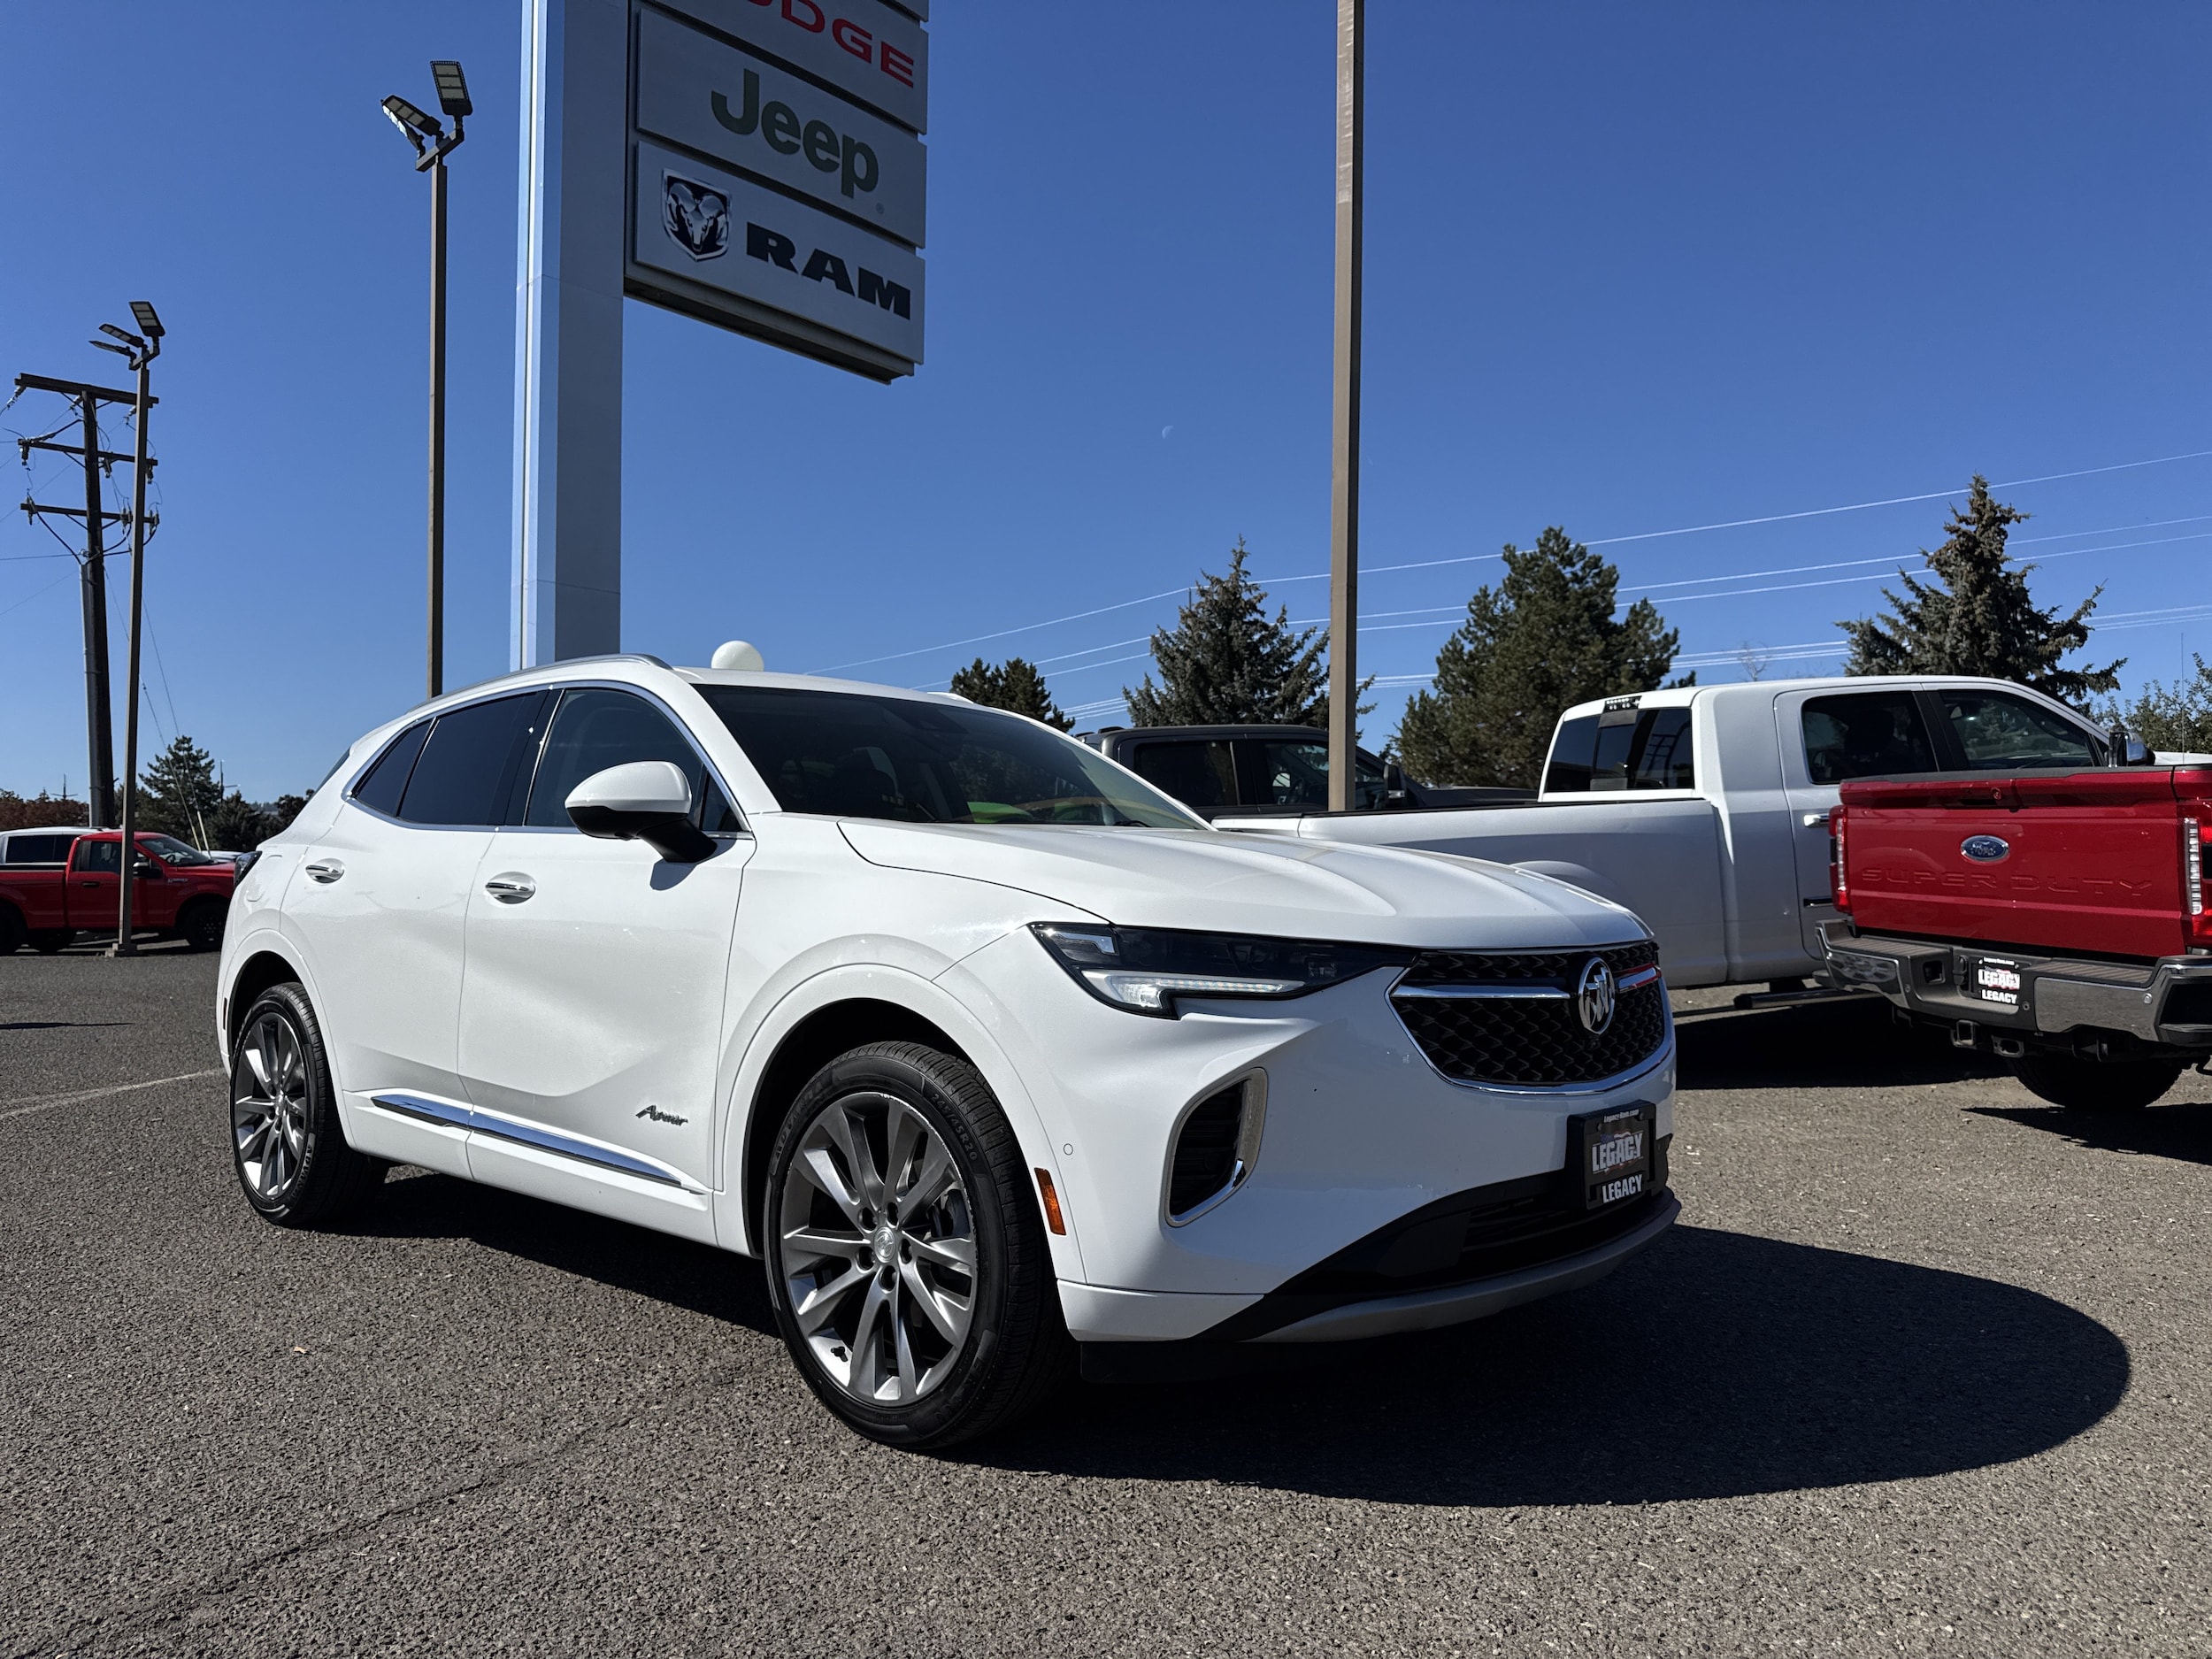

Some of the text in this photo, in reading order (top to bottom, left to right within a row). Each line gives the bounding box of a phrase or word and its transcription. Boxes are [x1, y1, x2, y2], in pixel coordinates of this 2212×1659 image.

[748, 0, 914, 89] DGE
[710, 67, 879, 199] Jeep
[747, 221, 911, 321] RAM
[1862, 869, 2153, 896] SUPER DUTY
[1978, 968, 2020, 990] LEGACY
[1981, 989, 2017, 1004] LEGACY
[932, 1093, 978, 1161] 245/45R20
[1592, 1132, 1643, 1172] LEGACY
[1601, 1173, 1643, 1204] LEGACY
